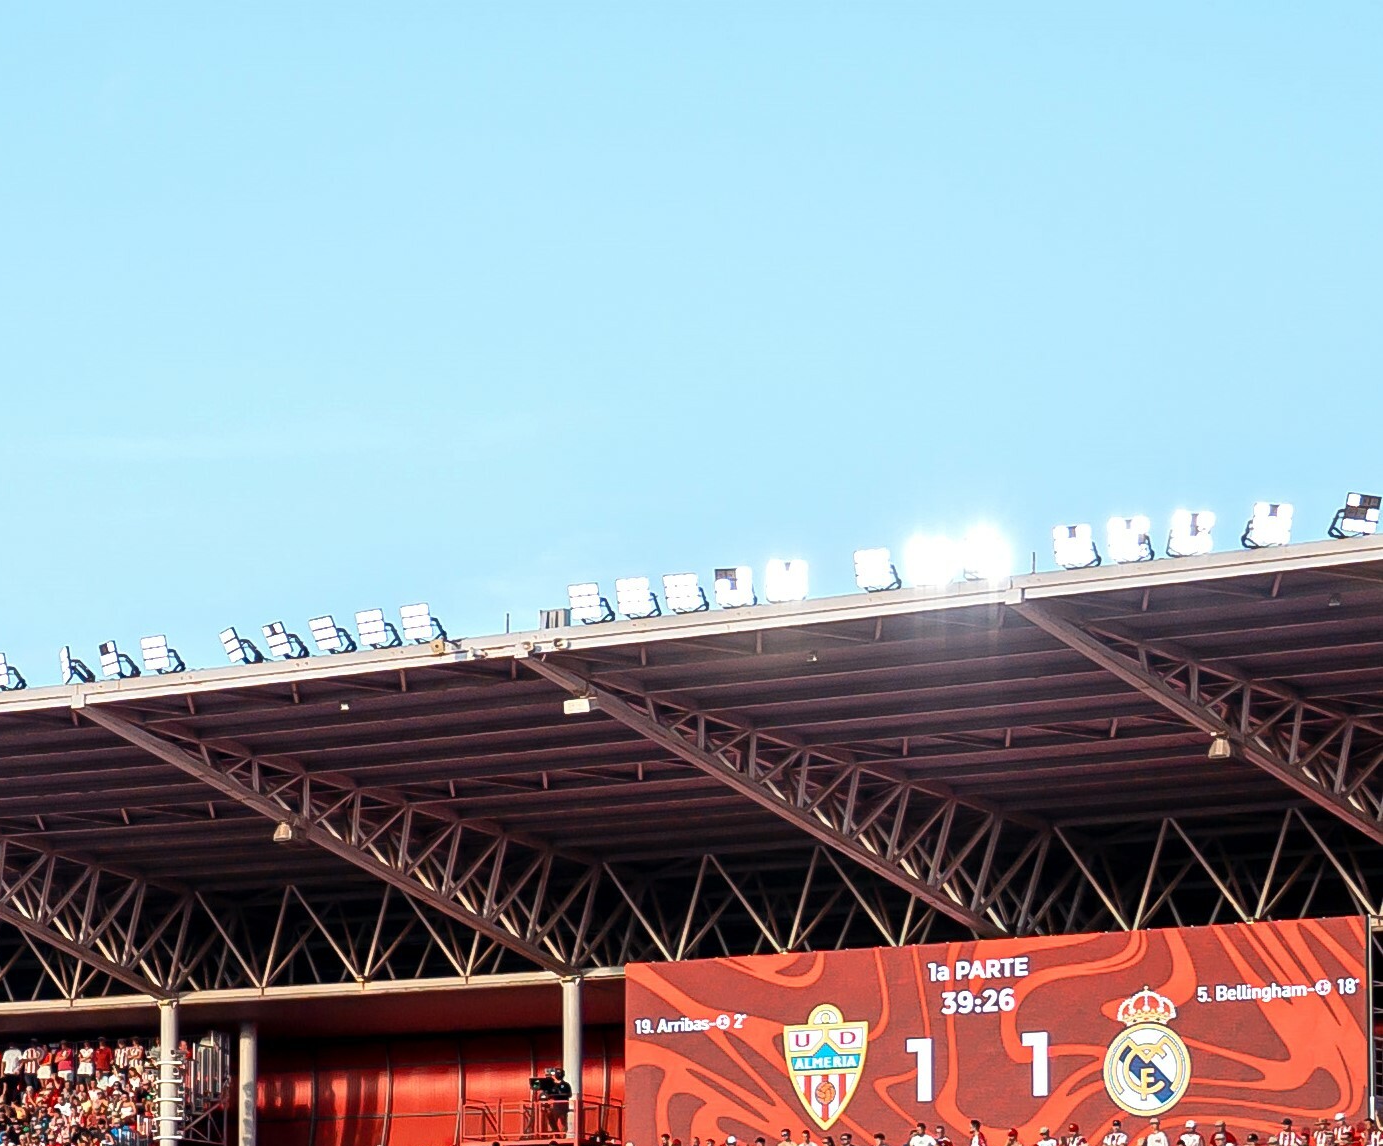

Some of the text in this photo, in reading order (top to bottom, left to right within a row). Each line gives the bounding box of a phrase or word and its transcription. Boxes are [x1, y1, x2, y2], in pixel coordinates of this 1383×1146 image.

[927, 957, 1029, 981] 1a PARTE
[940, 988, 1015, 1015] 39:26
[1196, 986, 1213, 1003] 5.
[634, 1019, 654, 1034] 19.
[795, 1031, 856, 1048] U D
[793, 1055, 858, 1070] ALMERIA
[906, 1038, 932, 1102] 1
[1021, 1031, 1048, 1096] 1
